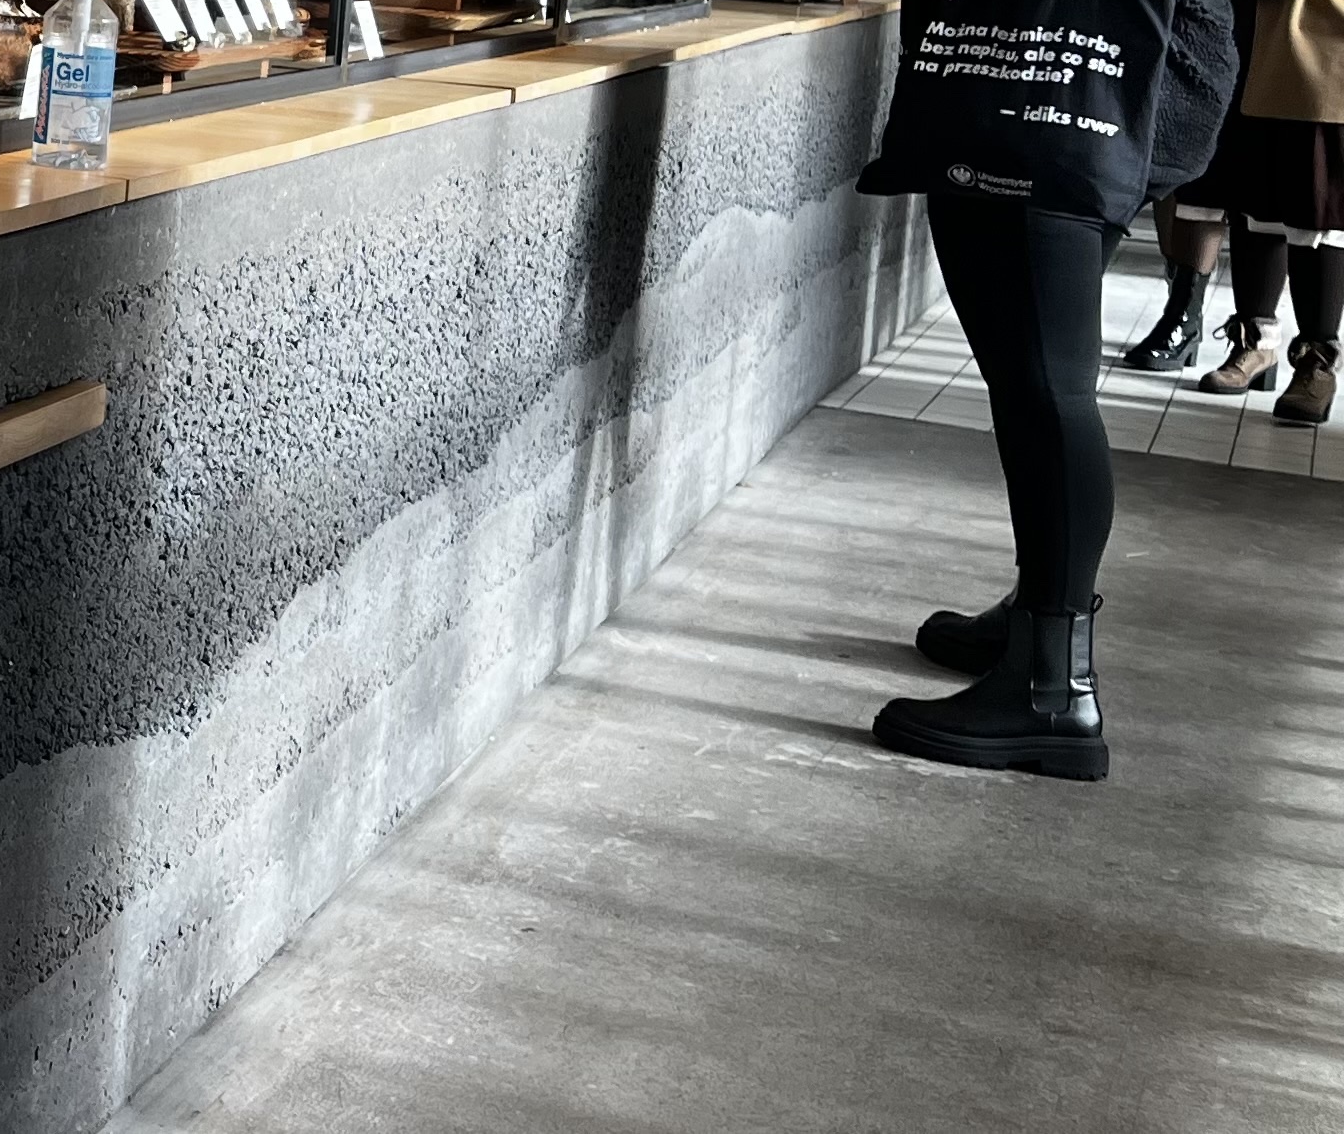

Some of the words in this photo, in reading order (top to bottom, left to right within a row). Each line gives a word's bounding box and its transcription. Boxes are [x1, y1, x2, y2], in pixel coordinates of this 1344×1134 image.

[919, 37, 955, 56] bez
[957, 42, 1020, 63] napisu,
[1023, 45, 1057, 63] ale
[1061, 51, 1084, 66] co
[925, 20, 989, 38] Można
[991, 24, 1018, 43] też
[1019, 25, 1064, 43] mieć
[1068, 29, 1122, 59] torbę
[56, 61, 90, 83] Gel
[913, 59, 940, 73] na
[942, 61, 1075, 85] przeszkodzie?
[1023, 105, 1072, 126] idiks
